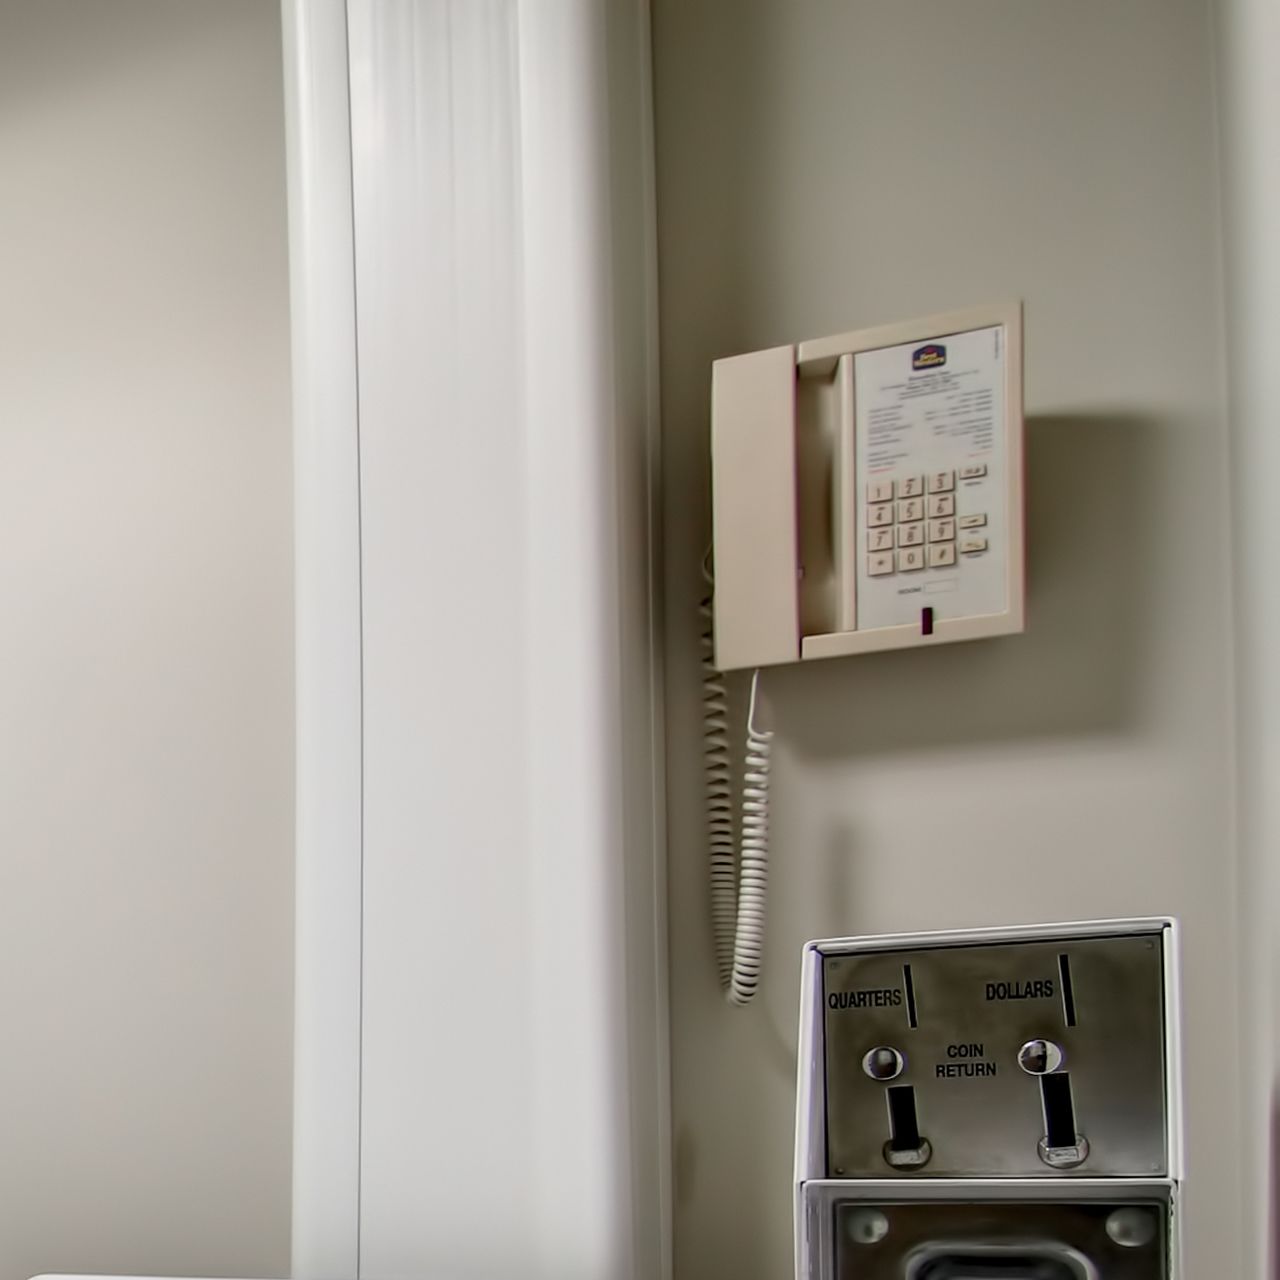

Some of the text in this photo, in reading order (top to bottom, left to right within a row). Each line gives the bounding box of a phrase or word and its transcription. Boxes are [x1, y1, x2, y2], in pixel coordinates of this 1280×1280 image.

[828, 989, 902, 1010] QUARTERS
[985, 980, 1054, 1001] DOLLARS
[947, 1044, 984, 1059] COIN
[935, 1063, 997, 1078] RETURN
